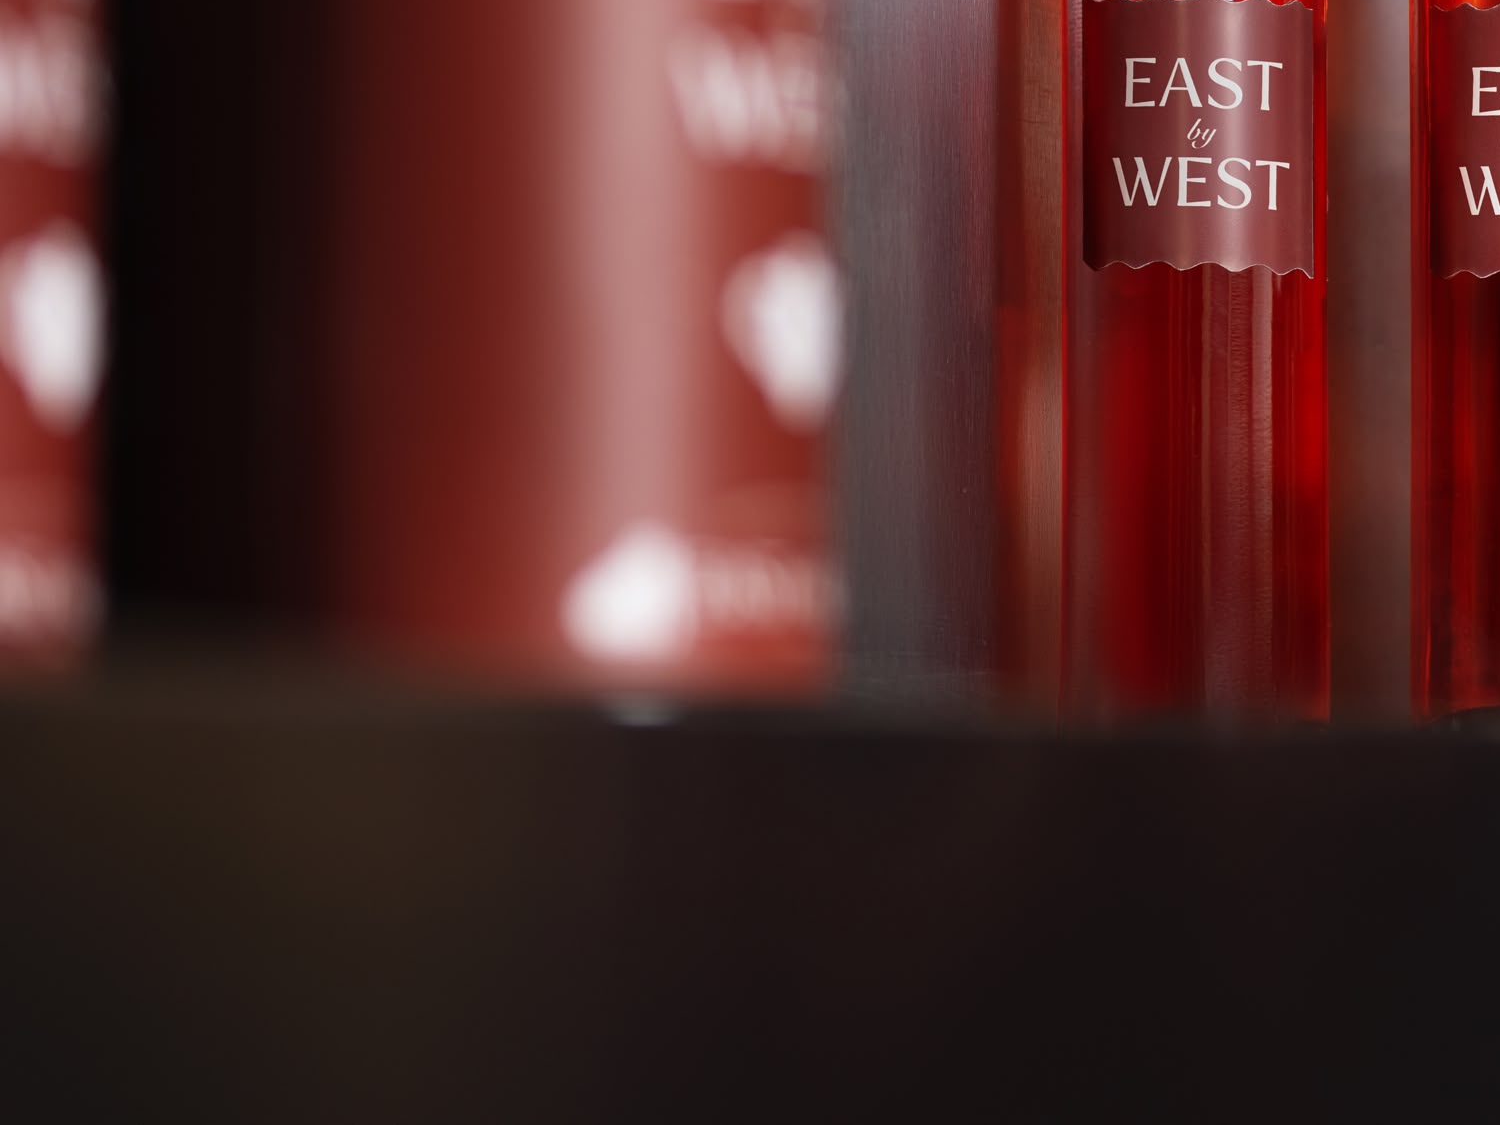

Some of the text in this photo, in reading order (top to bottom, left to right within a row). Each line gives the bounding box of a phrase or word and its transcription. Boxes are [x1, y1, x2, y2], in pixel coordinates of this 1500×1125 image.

[1124, 57, 1284, 112] EAST
[1186, 118, 1217, 149] by
[1111, 156, 1291, 211] WEST
